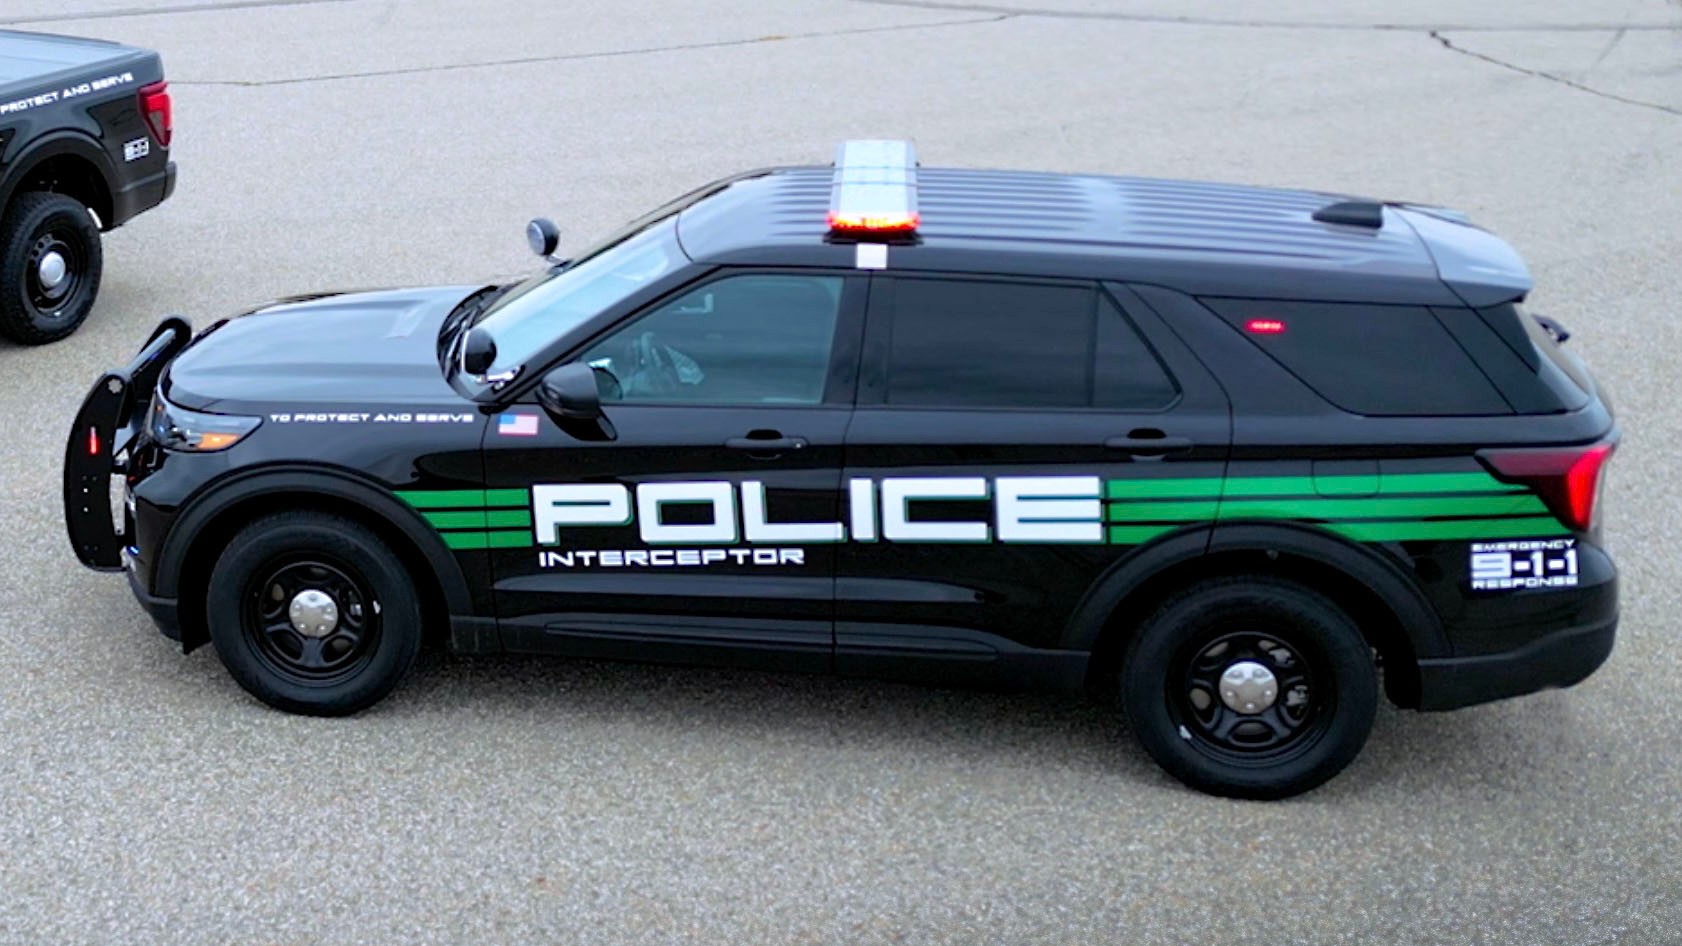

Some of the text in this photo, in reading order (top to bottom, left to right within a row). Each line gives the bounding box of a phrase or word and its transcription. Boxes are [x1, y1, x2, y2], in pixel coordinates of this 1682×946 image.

[0, 72, 134, 114] PROTECT AND SERVE
[270, 413, 474, 423] TO PROTECT AND SERVE
[532, 475, 1103, 544] POLICE
[1472, 539, 1576, 552] EMERGENCY
[538, 548, 805, 567] INTERCEPTOR
[1472, 549, 1578, 579] 9-1-1
[1472, 576, 1579, 590] RESPONSE
